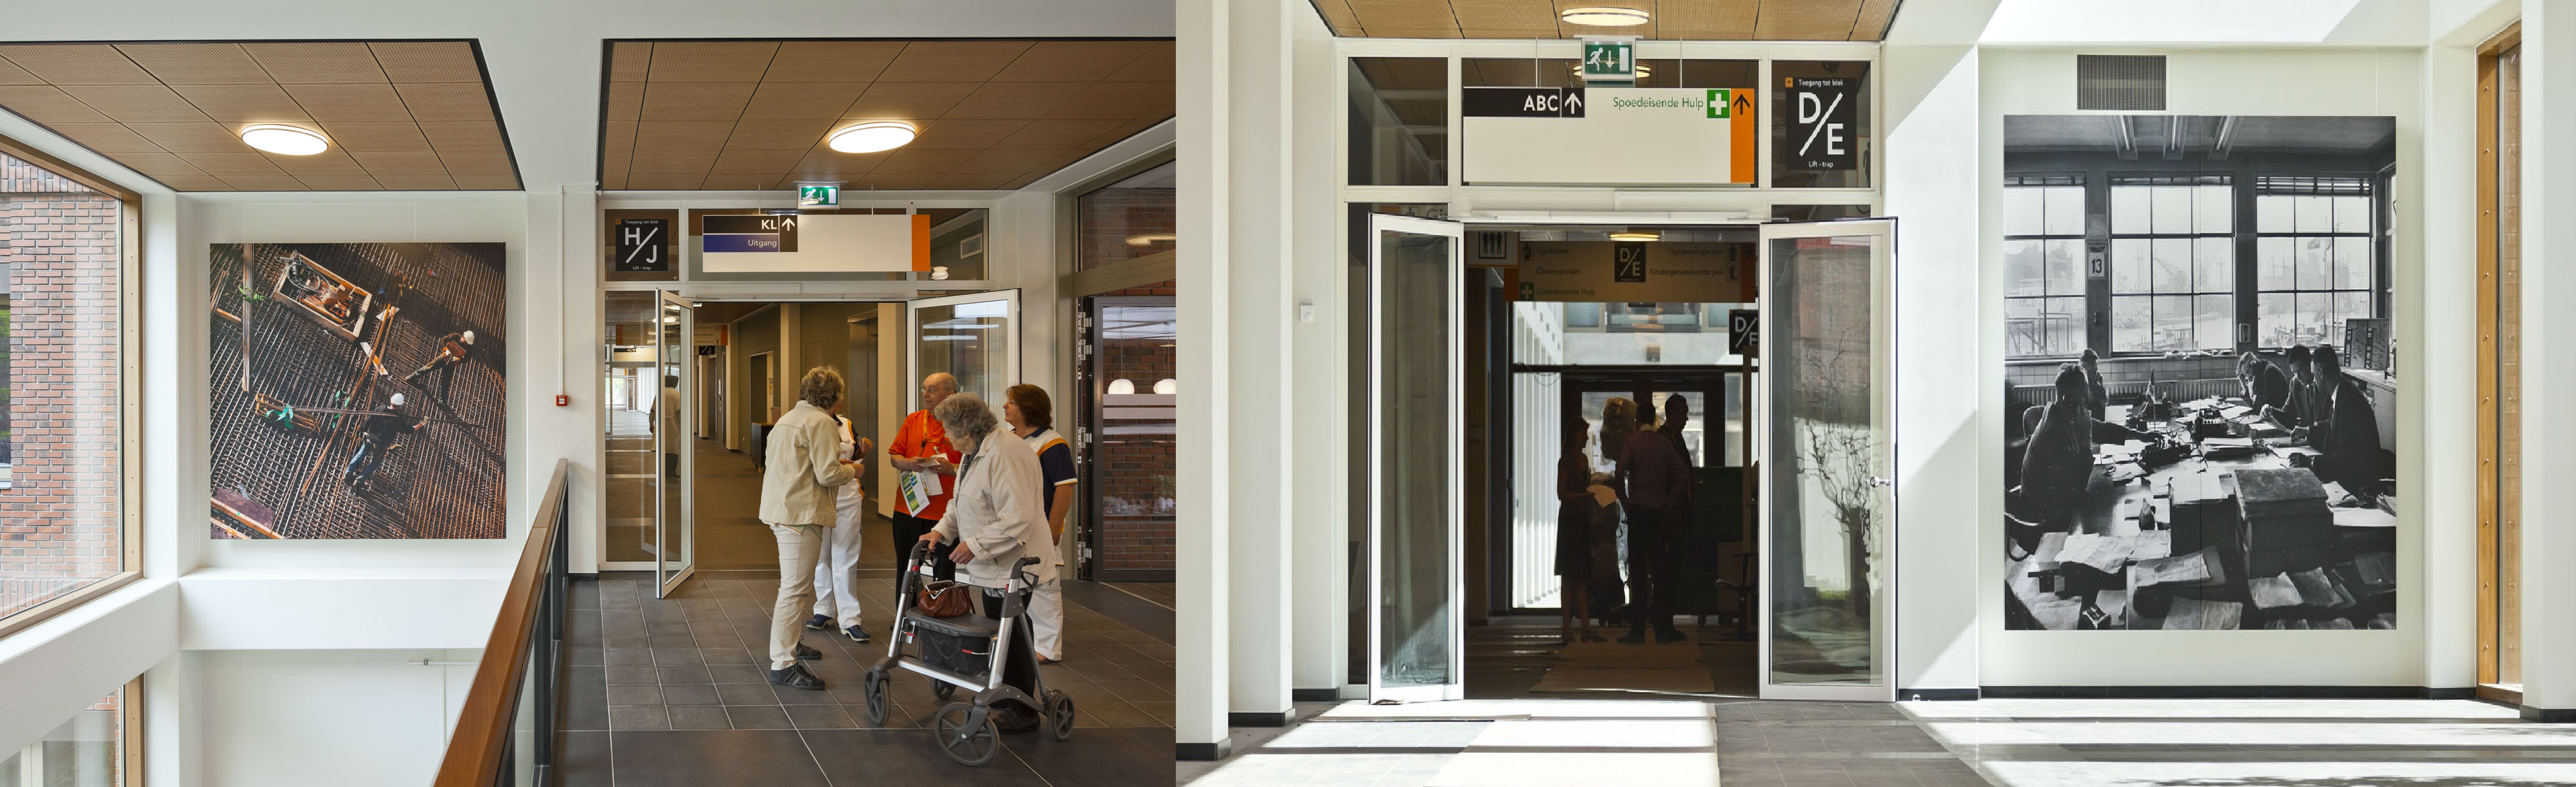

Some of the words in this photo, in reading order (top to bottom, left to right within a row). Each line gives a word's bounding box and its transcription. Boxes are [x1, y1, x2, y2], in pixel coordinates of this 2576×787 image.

[1799, 79, 1821, 87] Toegang
[1523, 94, 1559, 111] ABC
[1613, 96, 1679, 111] Spoedeisende
[1681, 96, 1704, 111] Hulp
[761, 220, 777, 230] KL
[748, 239, 777, 248] Uitgang
[2091, 258, 2102, 273] 13
